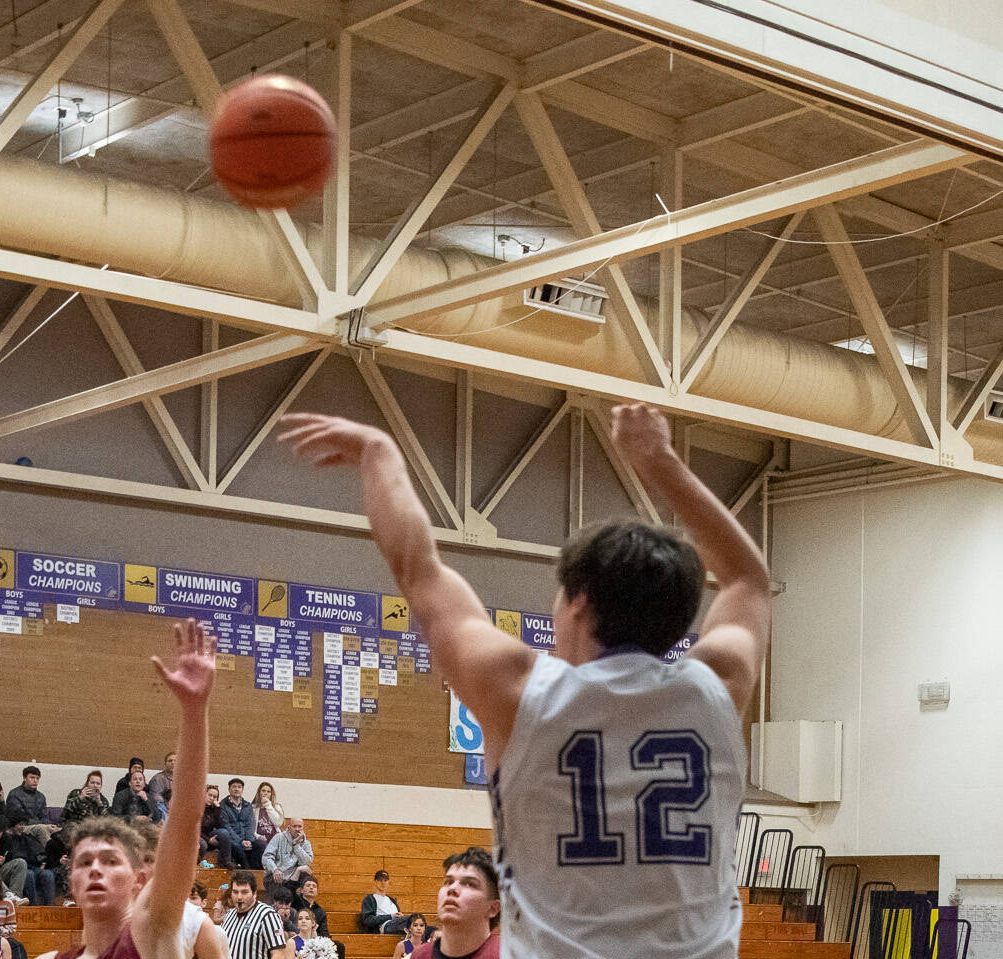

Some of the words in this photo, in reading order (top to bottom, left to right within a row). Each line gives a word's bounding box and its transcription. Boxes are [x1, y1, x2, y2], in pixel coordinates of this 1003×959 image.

[33, 559, 96, 577] SOCCER
[29, 575, 102, 592] CHAMPIONS
[166, 574, 242, 594] SWIMMING
[76, 597, 96, 606] GIRLS
[170, 591, 237, 608] CHAMPIONS
[306, 590, 355, 607] TENNIS
[148, 605, 165, 613] BOYS
[300, 605, 362, 622] CHAMPIONS
[526, 618, 554, 630] VOLL
[558, 729, 712, 866] 12
